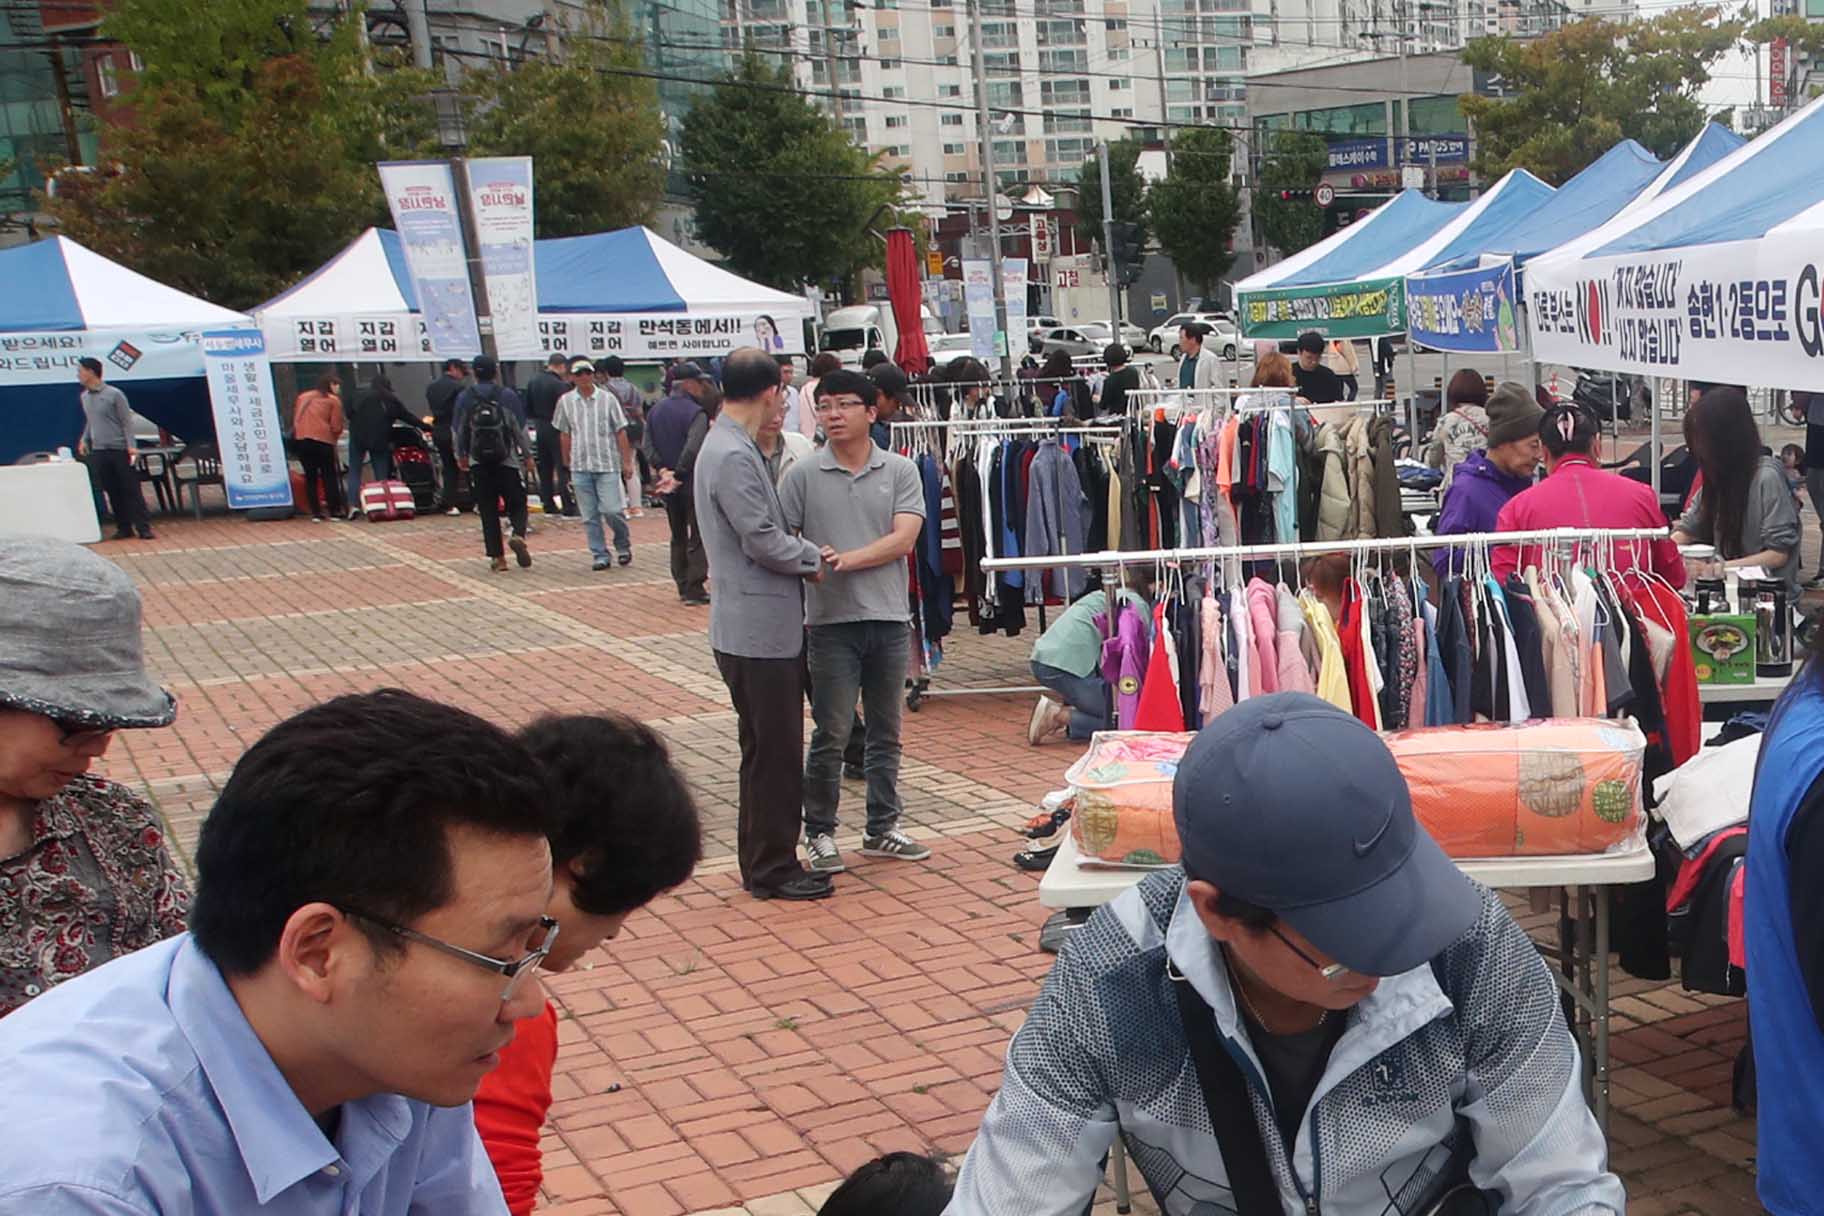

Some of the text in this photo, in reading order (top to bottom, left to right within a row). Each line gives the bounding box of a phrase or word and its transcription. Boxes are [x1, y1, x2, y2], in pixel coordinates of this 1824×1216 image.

[1318, 188, 1331, 202] 40
[298, 320, 335, 336] 지갑
[360, 320, 395, 336] 지갑
[590, 320, 622, 335] 지갑
[299, 338, 337, 353] 열어
[361, 338, 397, 353] 열어
[591, 336, 622, 351] 열어
